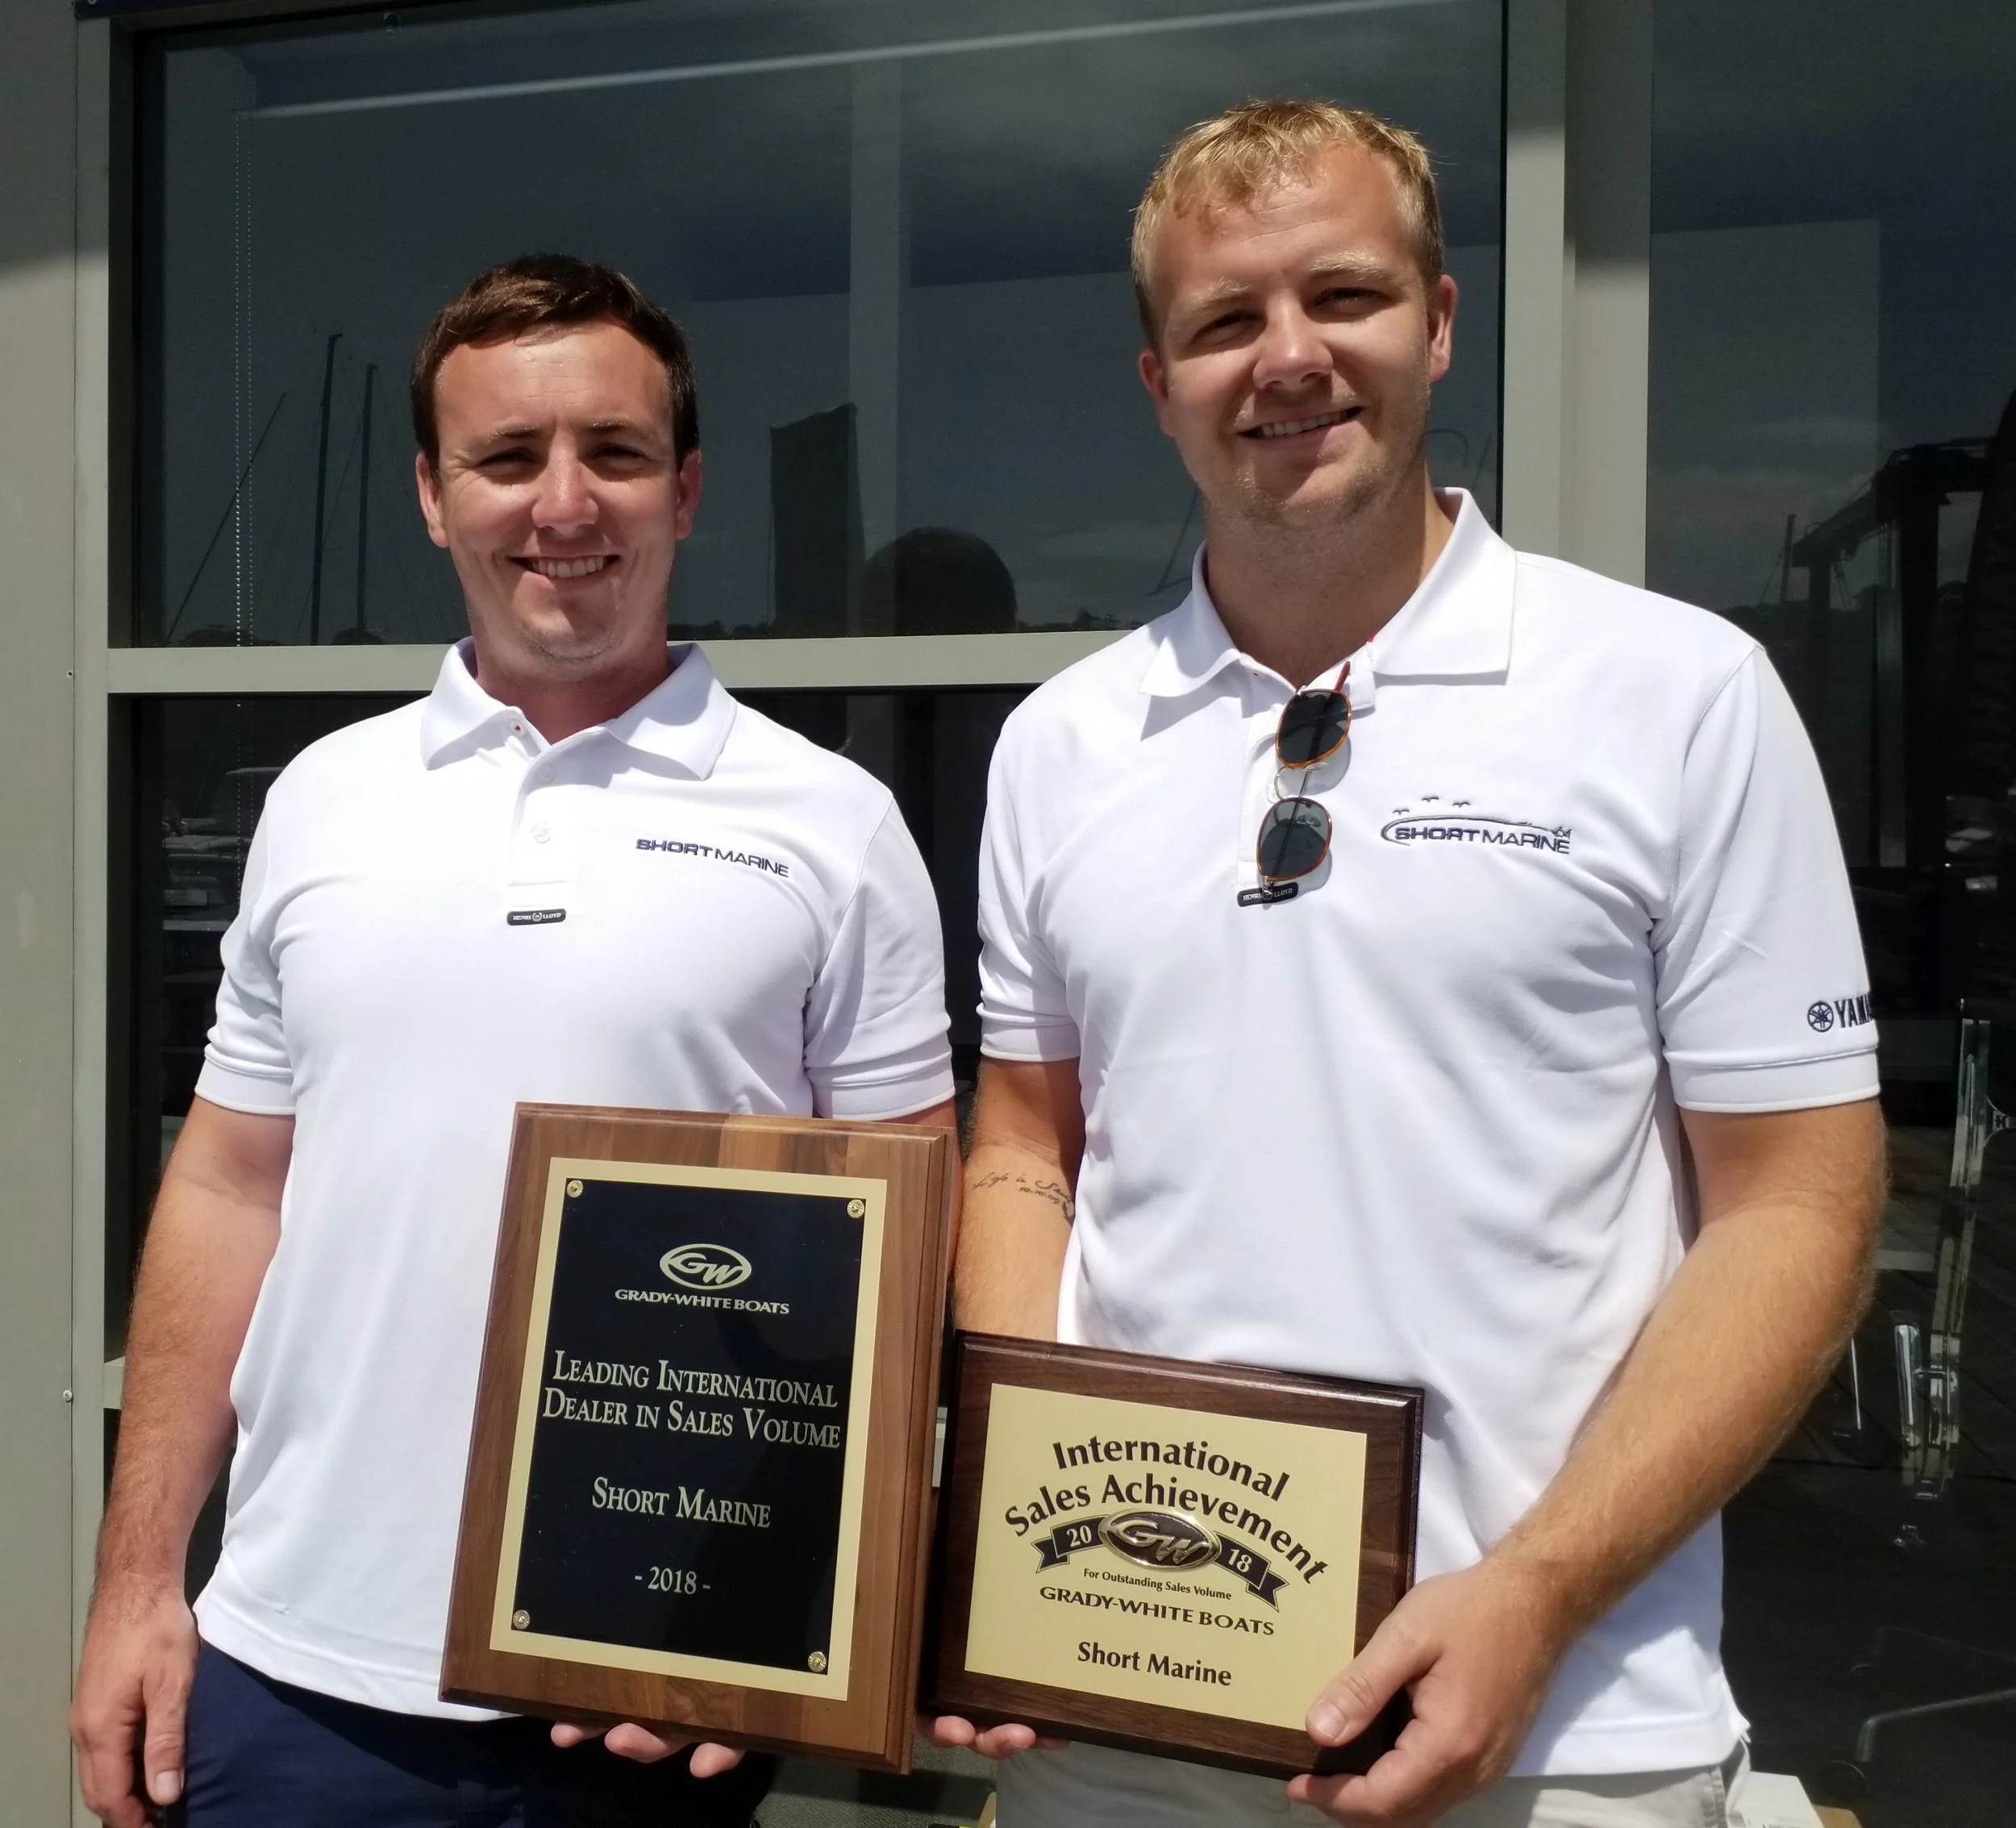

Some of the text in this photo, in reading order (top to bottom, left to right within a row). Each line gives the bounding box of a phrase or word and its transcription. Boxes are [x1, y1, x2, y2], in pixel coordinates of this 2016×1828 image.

[1274, 888, 1293, 897] LLOYD
[667, 1251, 745, 1285] GW
[614, 1289, 790, 1314] GRADY-WHITE BOATS
[552, 1349, 838, 1408] LEADING INTERNATIONAL
[543, 1387, 628, 1426] DEALER
[668, 1399, 733, 1436] SALES
[742, 1407, 841, 1449] VOLUME
[1052, 1435, 1290, 1502] International
[591, 1476, 771, 1529] SHORT MARINE
[1004, 1472, 1328, 1585] Sales Achievement
[1065, 1525, 1093, 1548] 20
[1228, 1547, 1253, 1574] 18
[1083, 1568, 1232, 1601] For Outstanding Sales Volume
[1039, 1585, 1275, 1636] GRADY-WHITE BOATS
[1077, 1641, 1233, 1687] Short Marine
